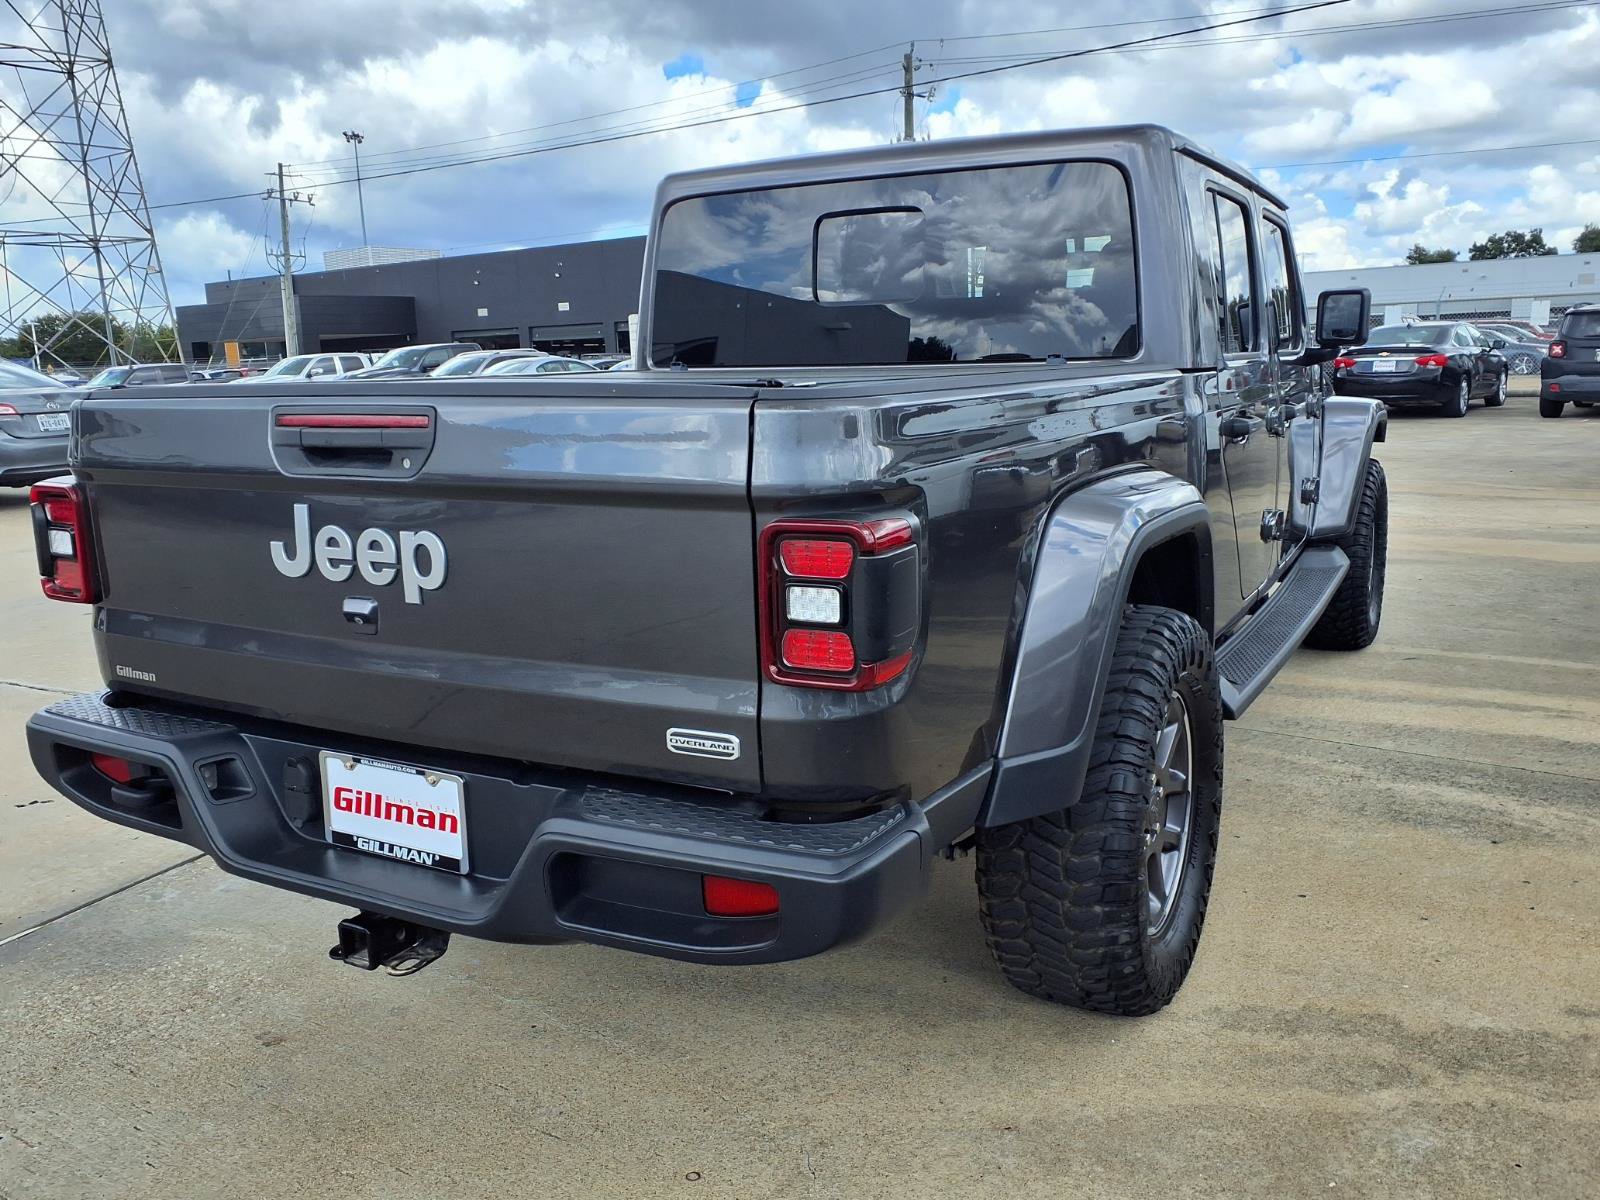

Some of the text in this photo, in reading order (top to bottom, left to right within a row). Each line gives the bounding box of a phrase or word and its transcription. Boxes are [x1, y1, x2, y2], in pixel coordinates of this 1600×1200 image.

[270, 503, 448, 604] Jeep
[116, 664, 156, 682] Gillman
[669, 738, 735, 752] OVERLAND
[360, 759, 417, 776] GILLMANAUTO.COM
[334, 786, 458, 834] Gillman
[357, 837, 433, 866] GILLMAN
